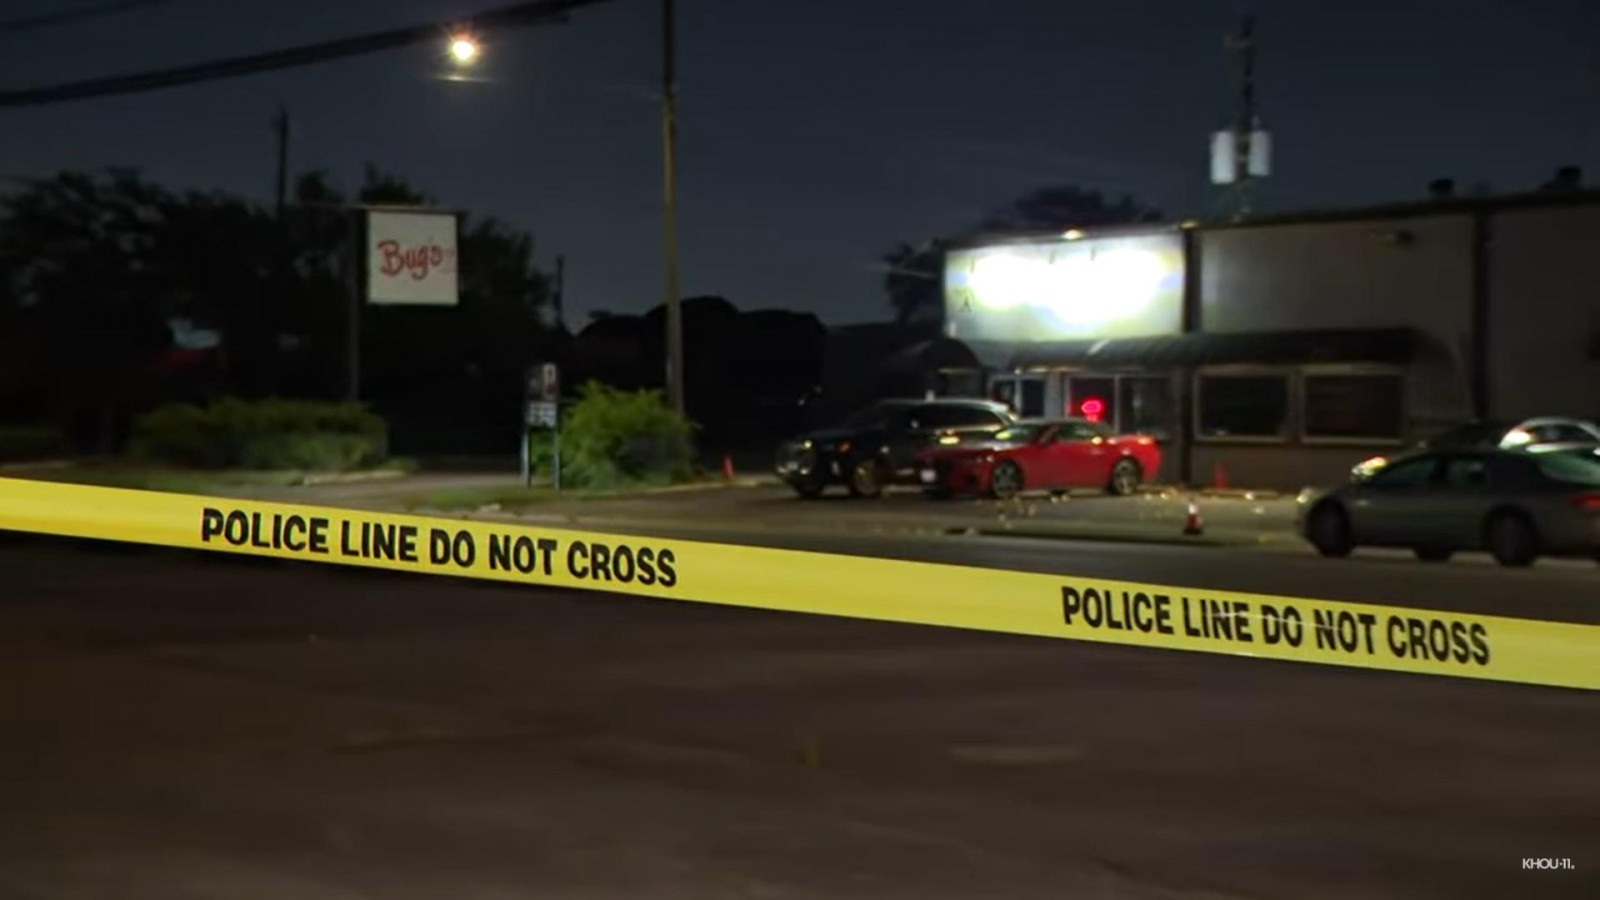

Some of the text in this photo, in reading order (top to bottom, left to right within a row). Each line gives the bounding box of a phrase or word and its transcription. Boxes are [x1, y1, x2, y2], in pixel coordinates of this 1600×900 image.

[201, 507, 677, 588] POLICE LINE DO NOT CROSS
[1061, 585, 1490, 666] POLICE LINE DO NOT CROSS
